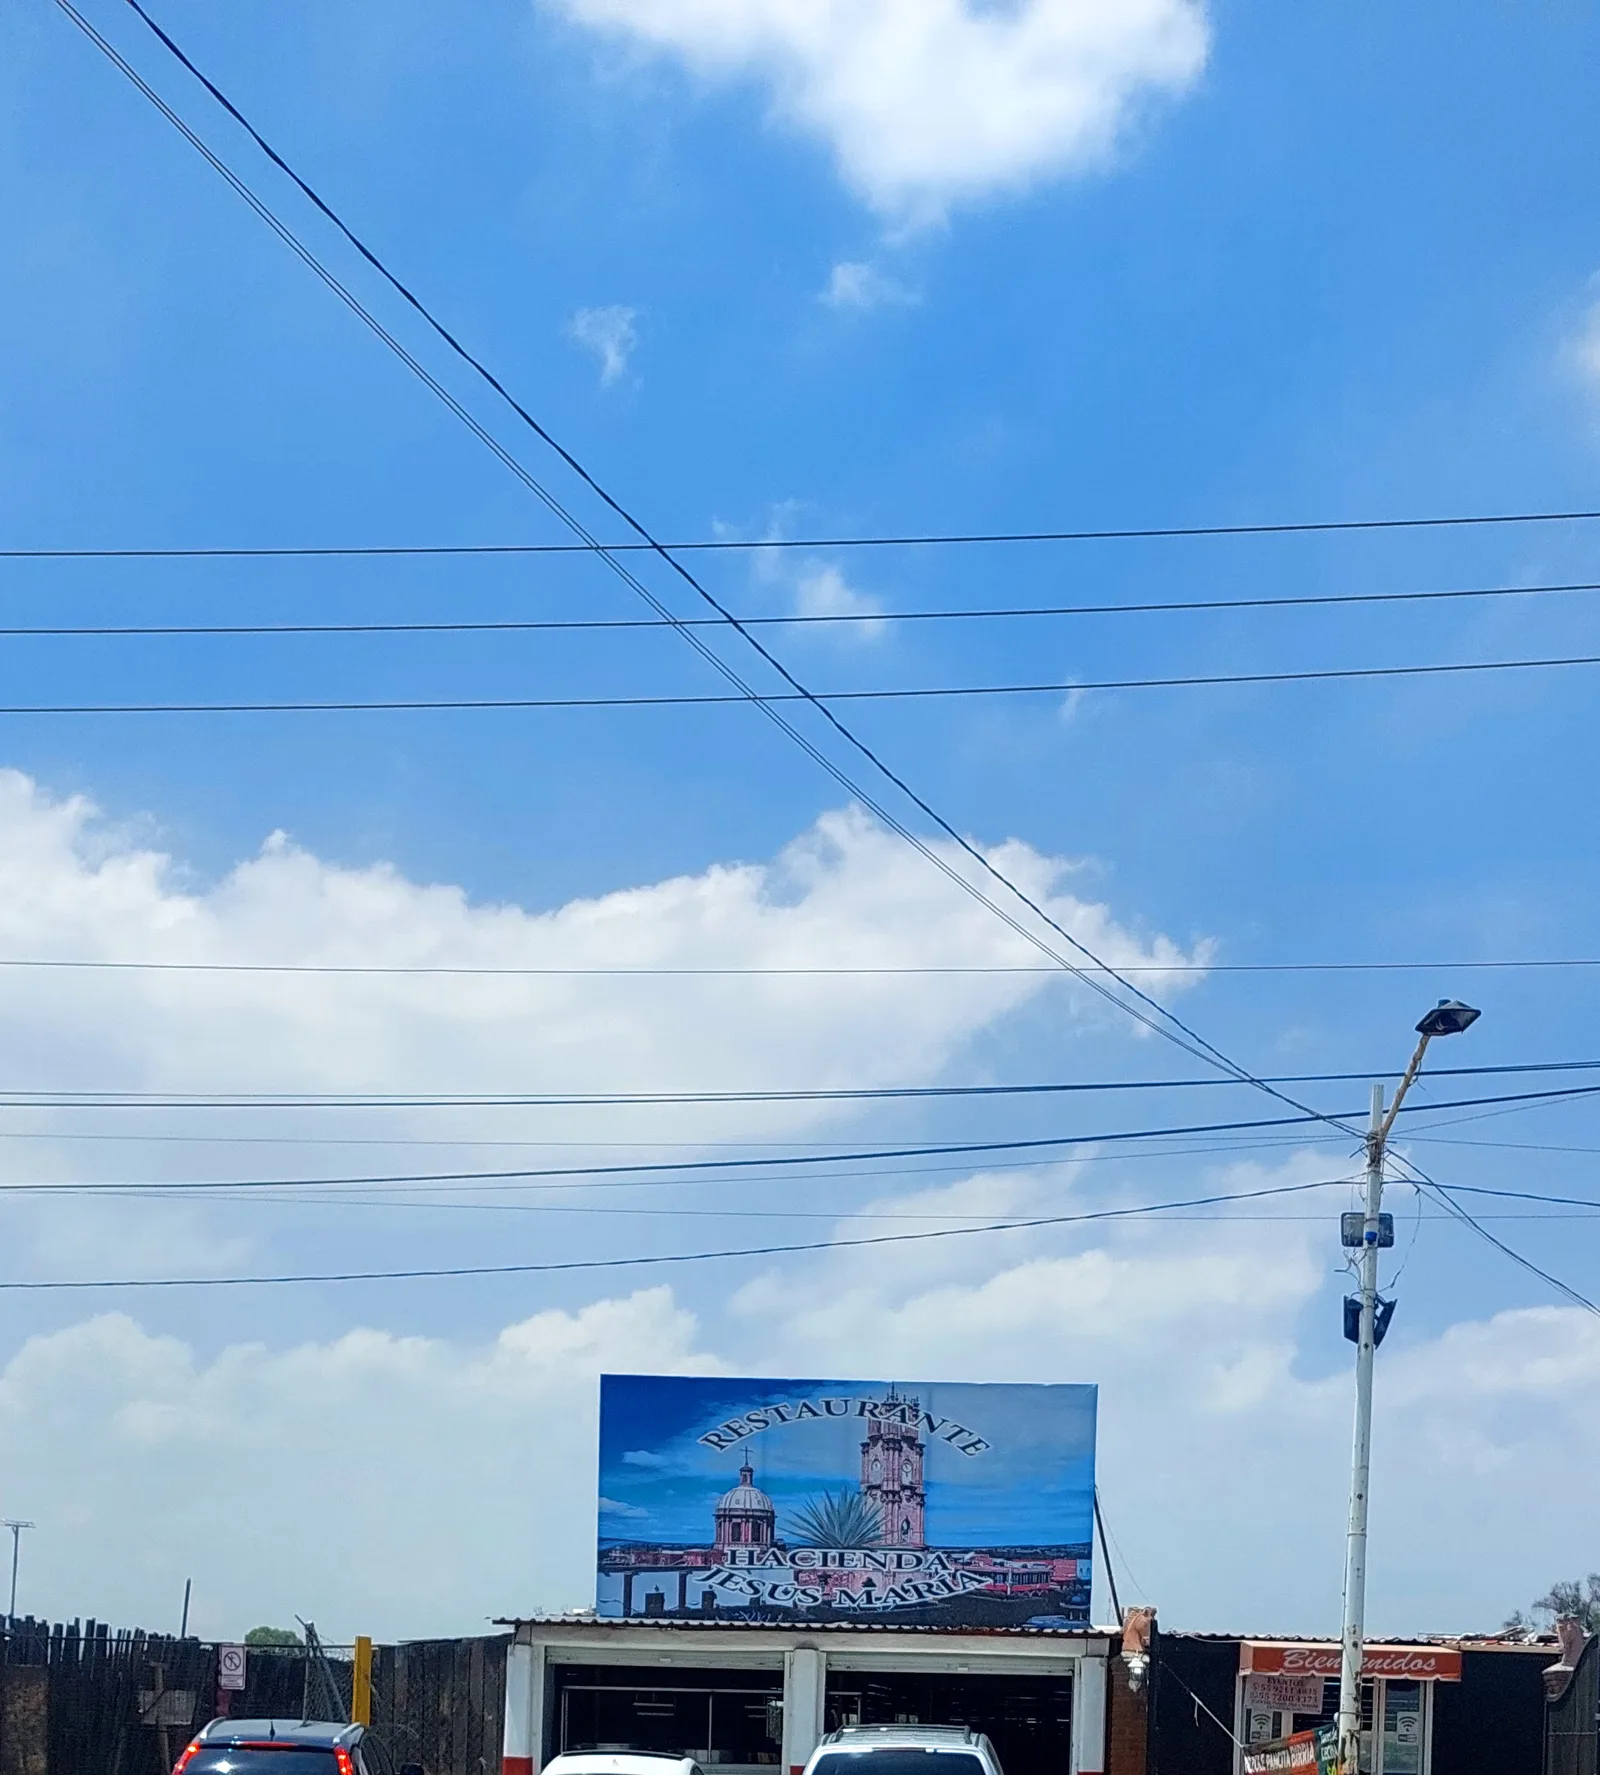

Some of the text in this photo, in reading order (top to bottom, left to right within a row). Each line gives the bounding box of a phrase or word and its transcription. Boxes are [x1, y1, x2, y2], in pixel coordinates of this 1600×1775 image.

[697, 1397, 991, 1458] RESTAURANTE
[726, 1549, 954, 1572] HACIENDA
[1283, 1649, 1437, 1672] Bienenidos
